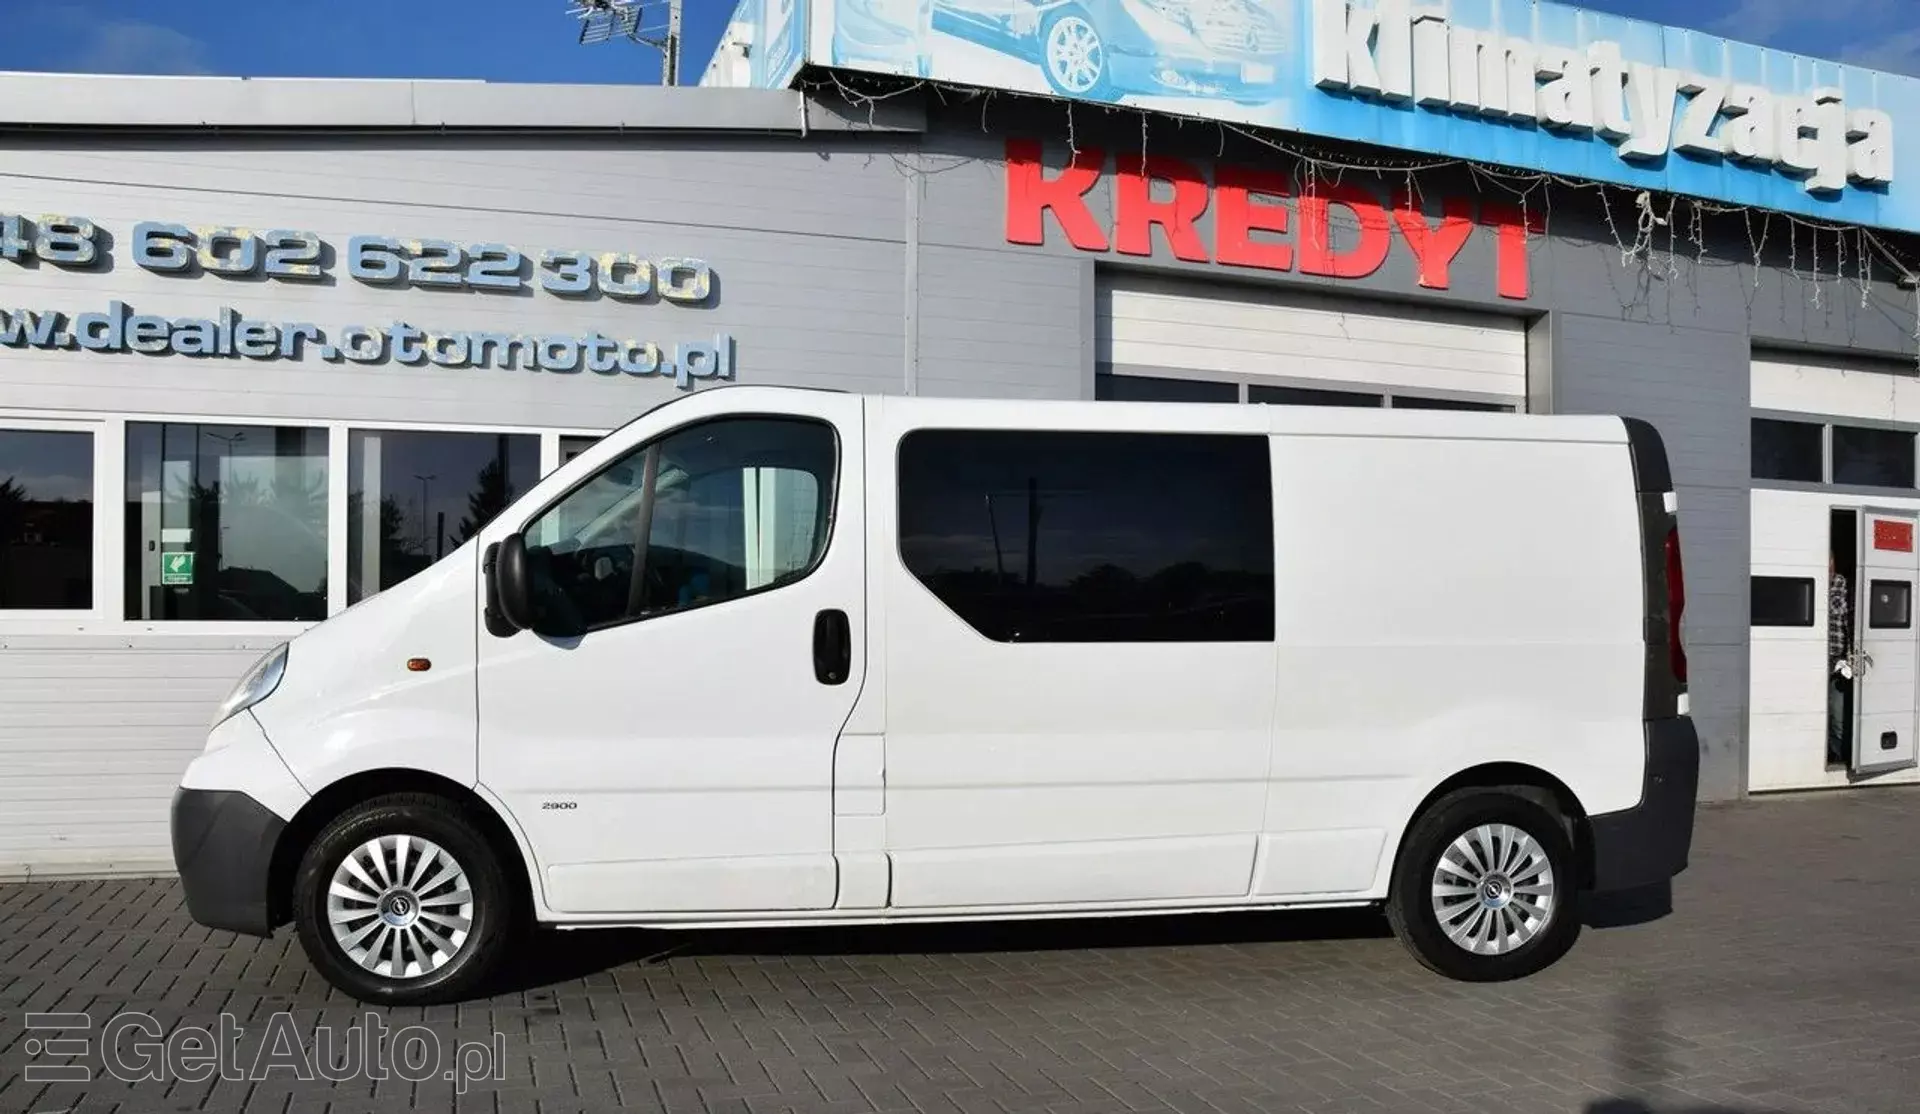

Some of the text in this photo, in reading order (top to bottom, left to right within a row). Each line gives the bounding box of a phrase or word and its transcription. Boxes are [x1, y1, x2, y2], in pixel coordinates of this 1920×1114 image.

[1314, 0, 1894, 194] klimatyzacja
[131, 220, 324, 283] 602
[347, 234, 525, 290] 622
[541, 248, 714, 303] 300
[1004, 138, 1547, 300] KREDYT
